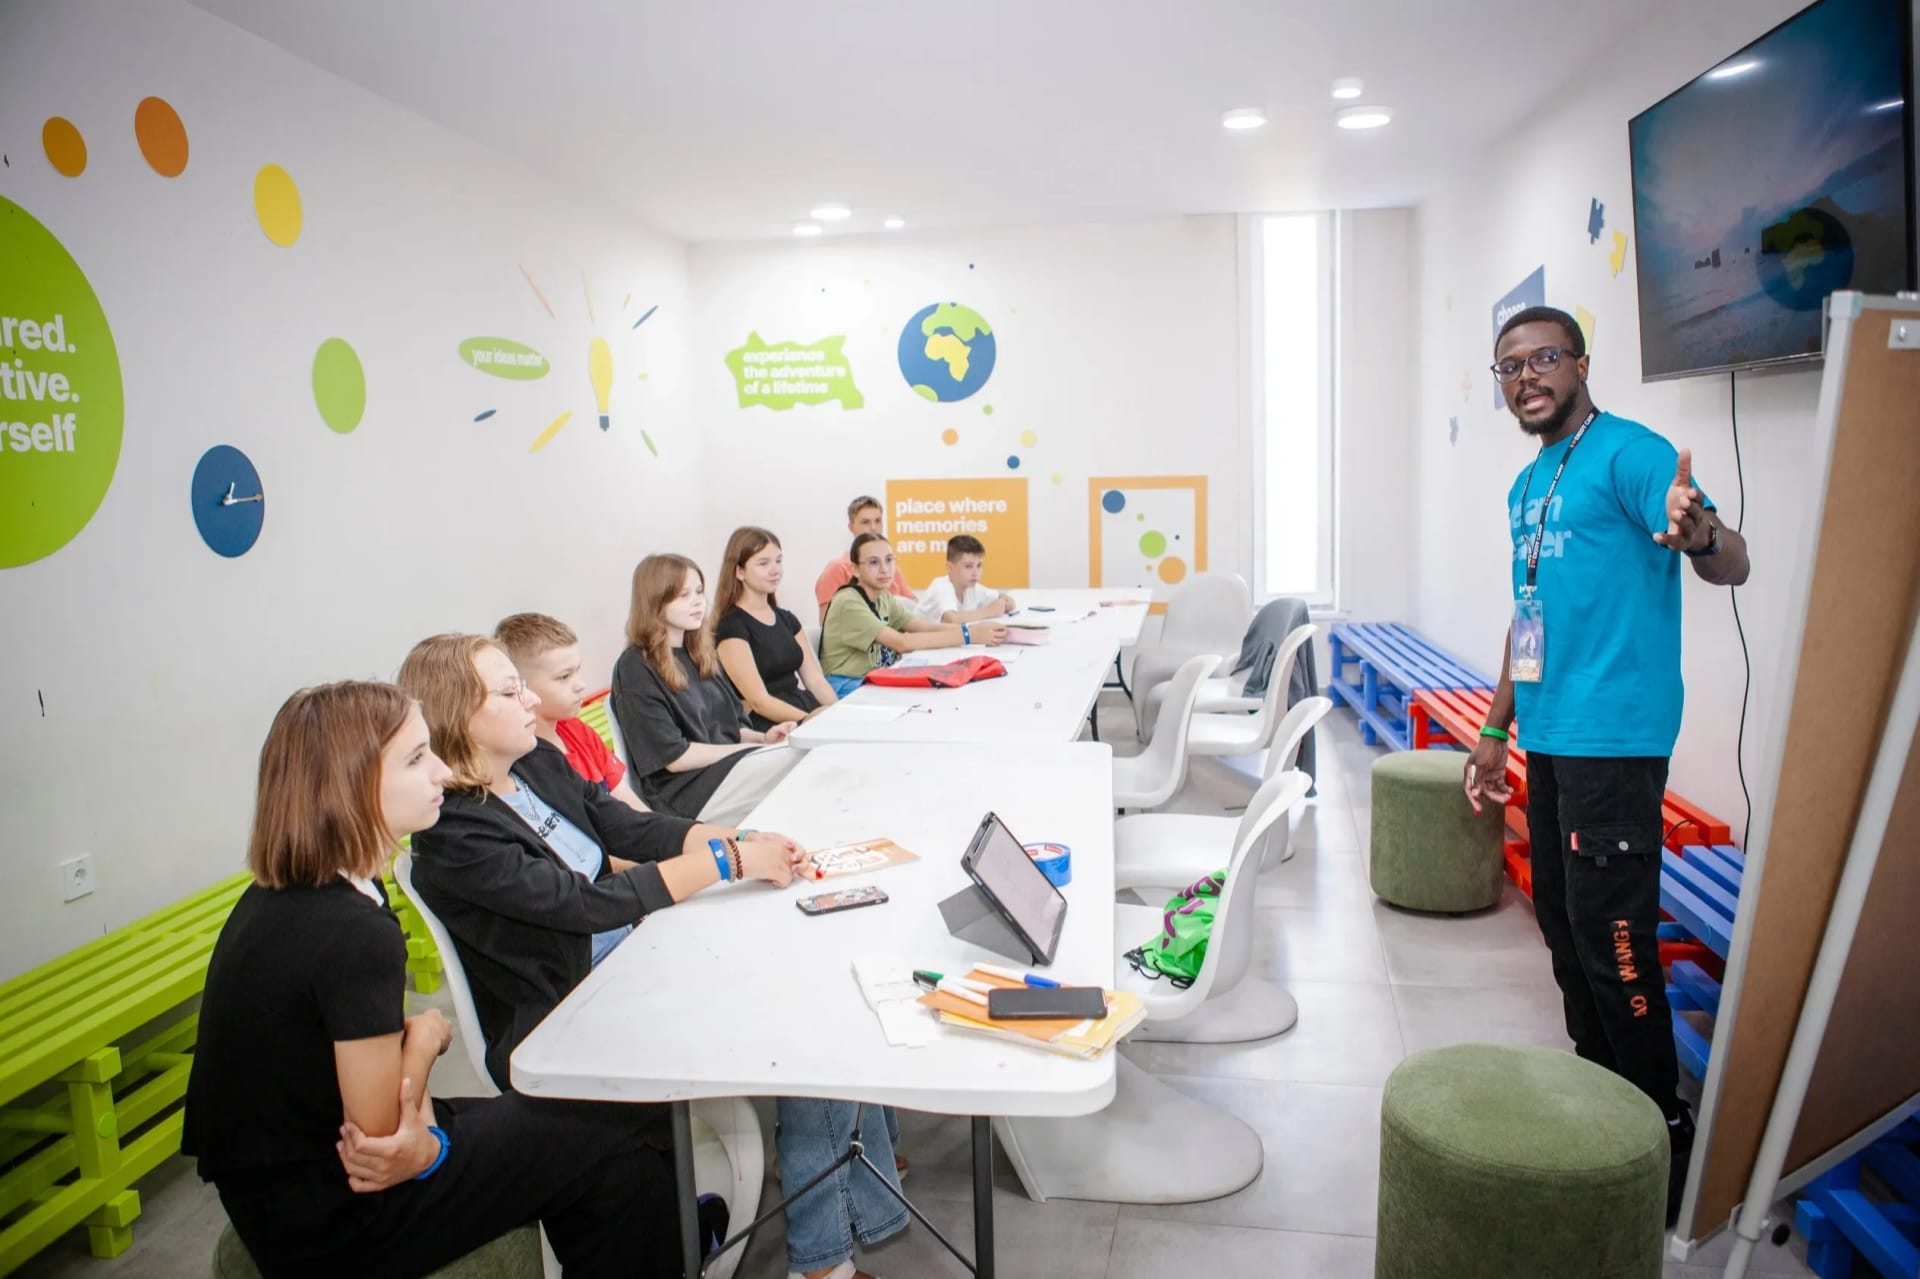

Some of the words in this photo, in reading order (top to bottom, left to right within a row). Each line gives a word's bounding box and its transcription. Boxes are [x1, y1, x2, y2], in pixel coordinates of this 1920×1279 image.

[0, 314, 76, 353] red.
[471, 349, 492, 366] your
[743, 348, 824, 366] experience
[0, 358, 79, 403] tive.
[744, 366, 767, 379] the
[771, 366, 845, 379] adventure
[744, 381, 758, 394] of
[762, 384, 770, 394] a
[773, 381, 829, 394] lifetime
[896, 498, 945, 517] place
[949, 497, 1008, 514] where
[896, 516, 988, 533] memories
[897, 540, 927, 553] are
